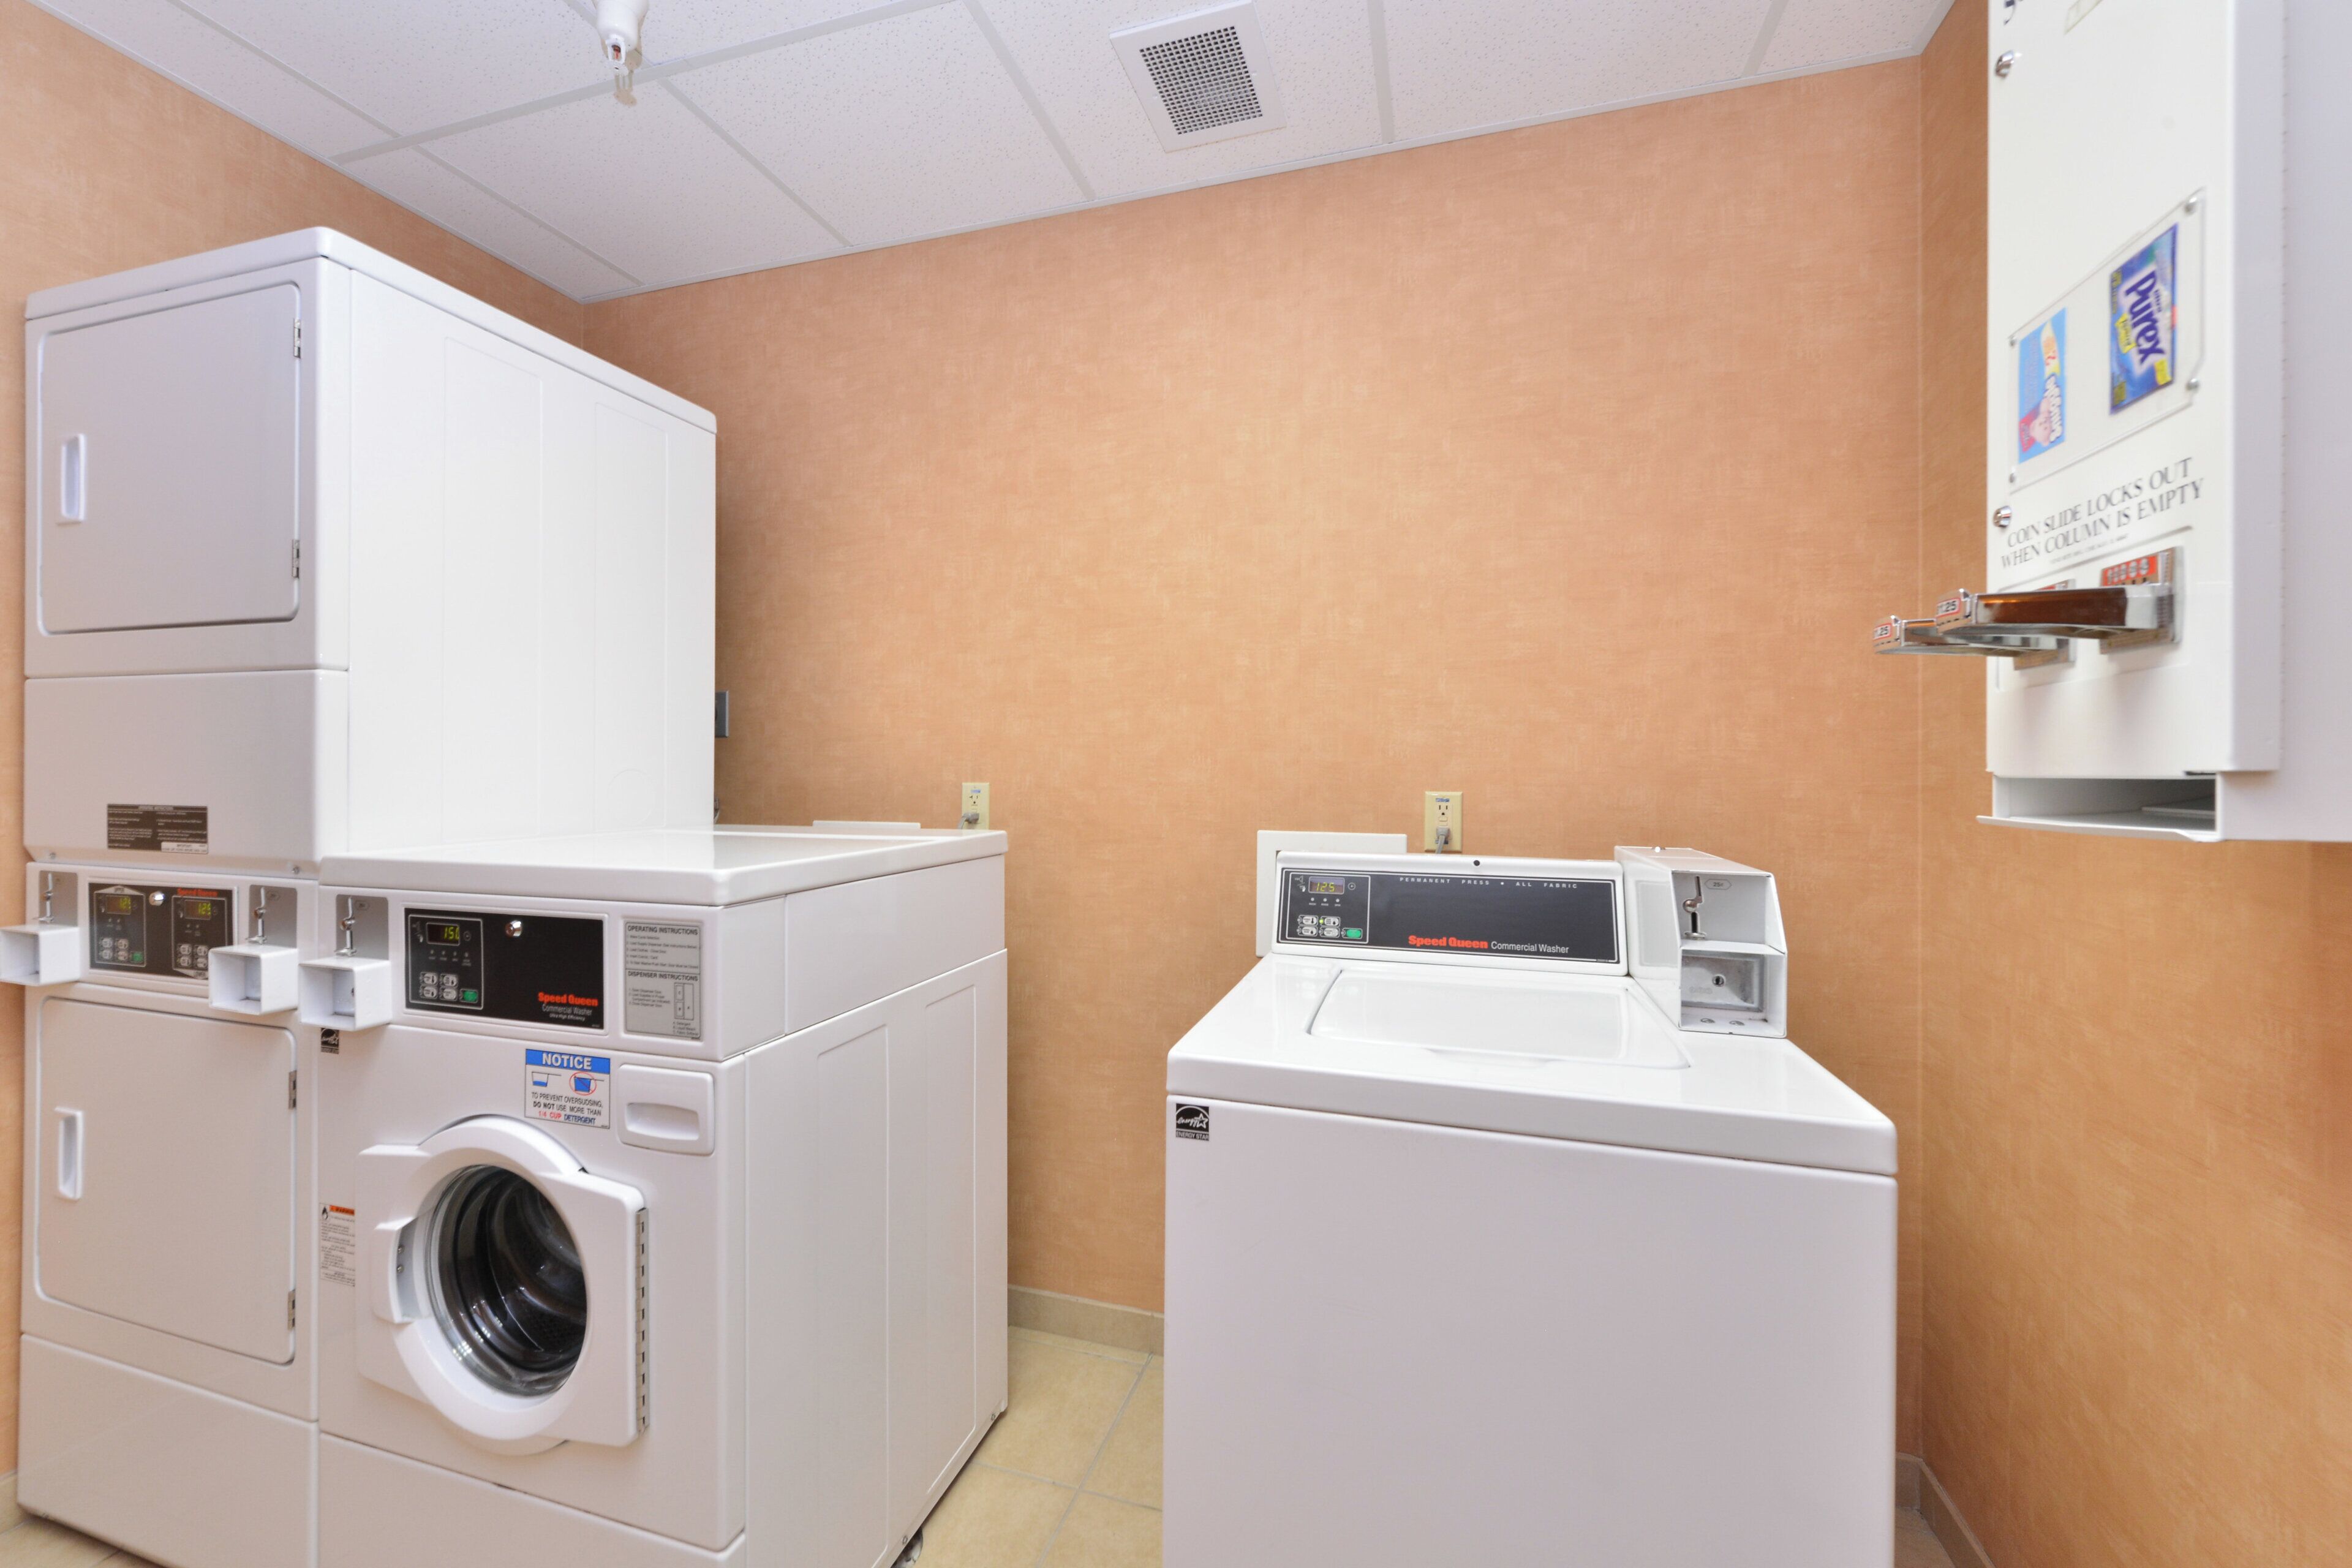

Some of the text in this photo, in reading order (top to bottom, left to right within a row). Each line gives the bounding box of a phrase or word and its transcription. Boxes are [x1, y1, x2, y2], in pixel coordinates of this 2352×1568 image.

[2124, 270, 2166, 366] Purex
[2007, 456, 2193, 548] COIN SLIDE LOCKS OUT
[2001, 541, 2041, 569] WHEN
[2045, 514, 2112, 554] COLUMN
[2117, 507, 2131, 529] IS
[2138, 478, 2204, 521] EMPTY
[1316, 882, 1335, 892] 125
[658, 927, 698, 936] INSTRUCTIONS
[1408, 935, 1569, 954] Speed Queen Commercial Washer
[658, 973, 698, 982] INSTRUCTIONS
[538, 992, 598, 1007] Speed Queen
[542, 1003, 592, 1016] Commercial Washer
[542, 1052, 592, 1070] NOTICE
[539, 1093, 563, 1102] PREVENT
[564, 1095, 603, 1108] OVERSUDSING,
[549, 1111, 562, 1120] CUP
[564, 1114, 596, 1125] DETERGENT
[569, 1106, 585, 1114] MORE
[587, 1107, 601, 1117] THAN
[1176, 1131, 1196, 1139] ENERGY
